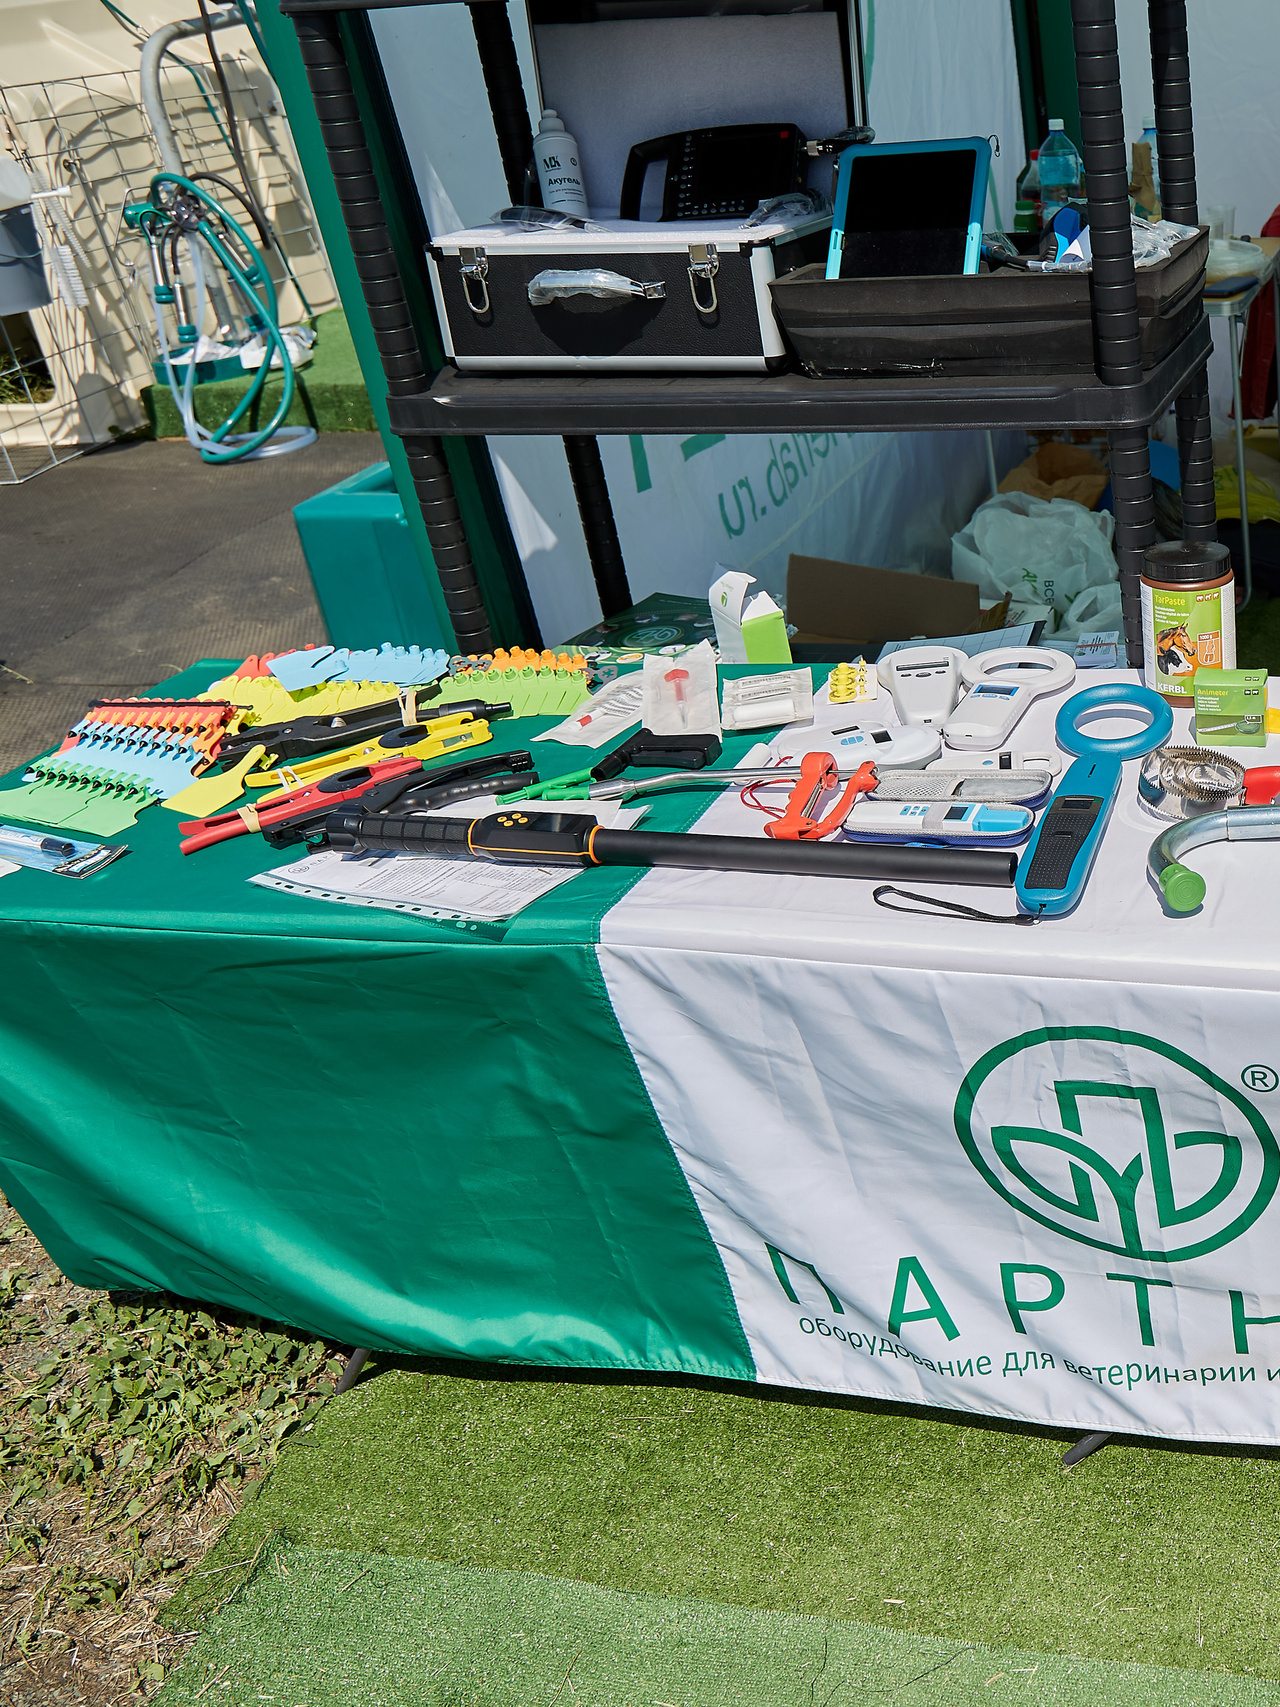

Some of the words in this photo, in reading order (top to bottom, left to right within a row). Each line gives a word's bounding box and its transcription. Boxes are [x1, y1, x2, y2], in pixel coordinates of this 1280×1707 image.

[1155, 594, 1186, 606] TarPaste
[1157, 682, 1188, 694] KERBL
[1197, 688, 1229, 696] Animeter
[798, 1315, 994, 1379] оборудование
[1002, 1350, 1056, 1377] для
[1063, 1360, 1257, 1391] ветеринарии
